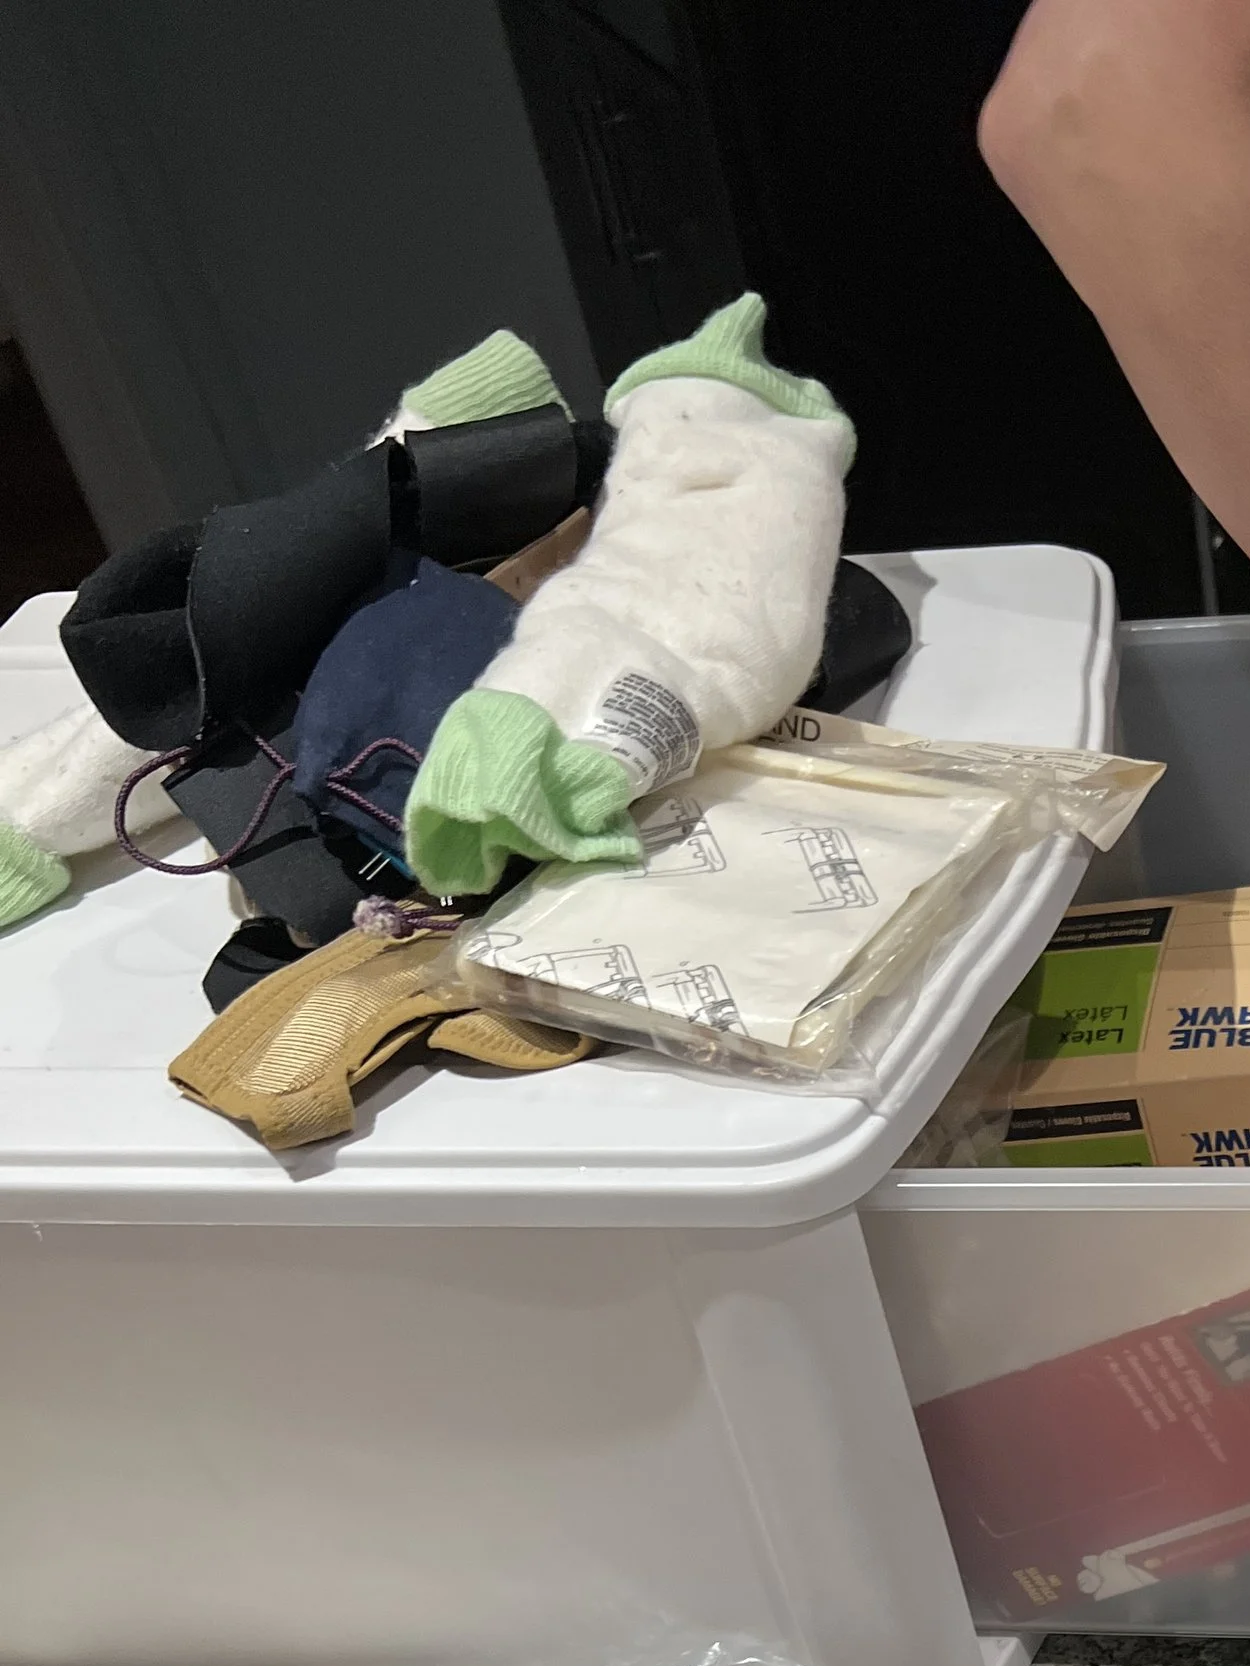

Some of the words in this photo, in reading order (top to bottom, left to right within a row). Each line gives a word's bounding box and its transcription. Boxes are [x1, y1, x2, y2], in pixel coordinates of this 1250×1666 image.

[1050, 933, 1085, 943] Glove
[1062, 1004, 1128, 1023] Látex
[1057, 1027, 1123, 1046] Latex
